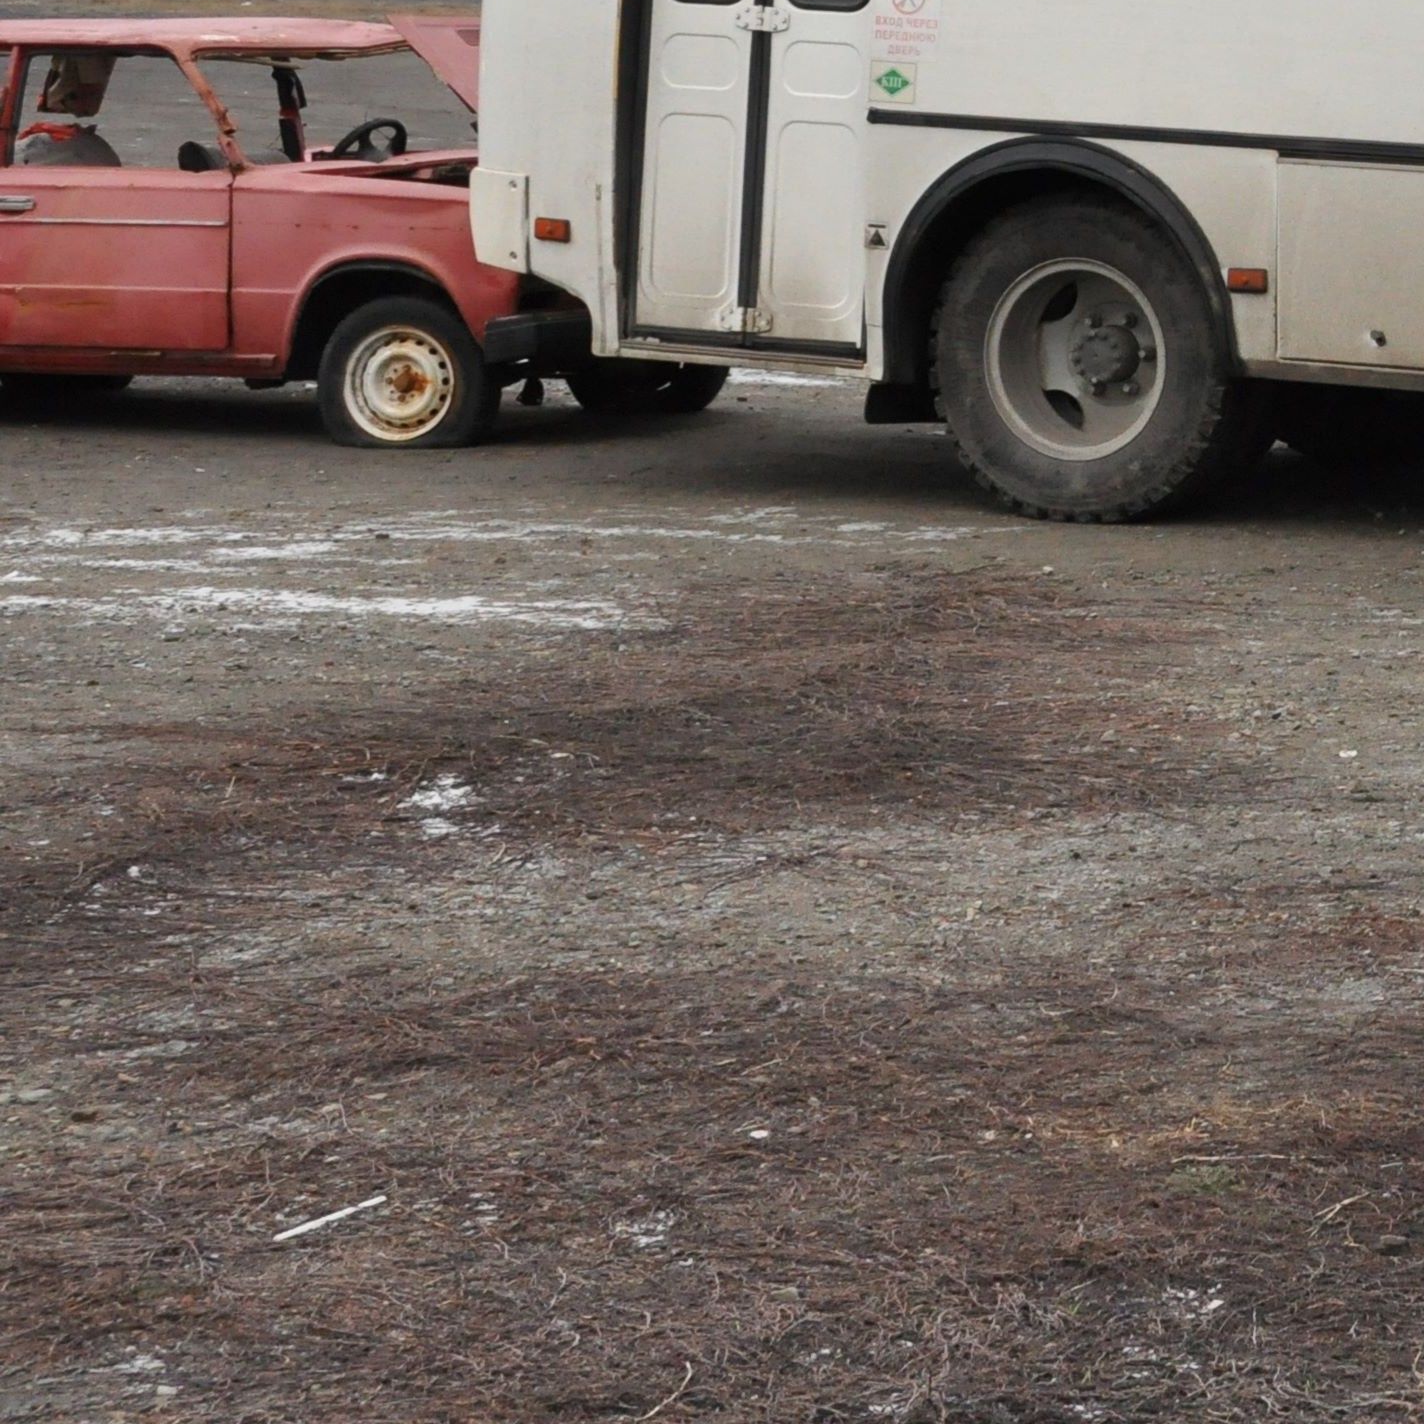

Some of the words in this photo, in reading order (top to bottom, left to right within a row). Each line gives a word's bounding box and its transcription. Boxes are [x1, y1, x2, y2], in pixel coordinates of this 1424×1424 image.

[875, 16, 903, 27] ВХОД
[907, 19, 938, 29] ЧЕРЕЗ
[875, 30, 936, 43] ПЕРЕДНЮЮ
[887, 44, 920, 56] ДВЕРЬ
